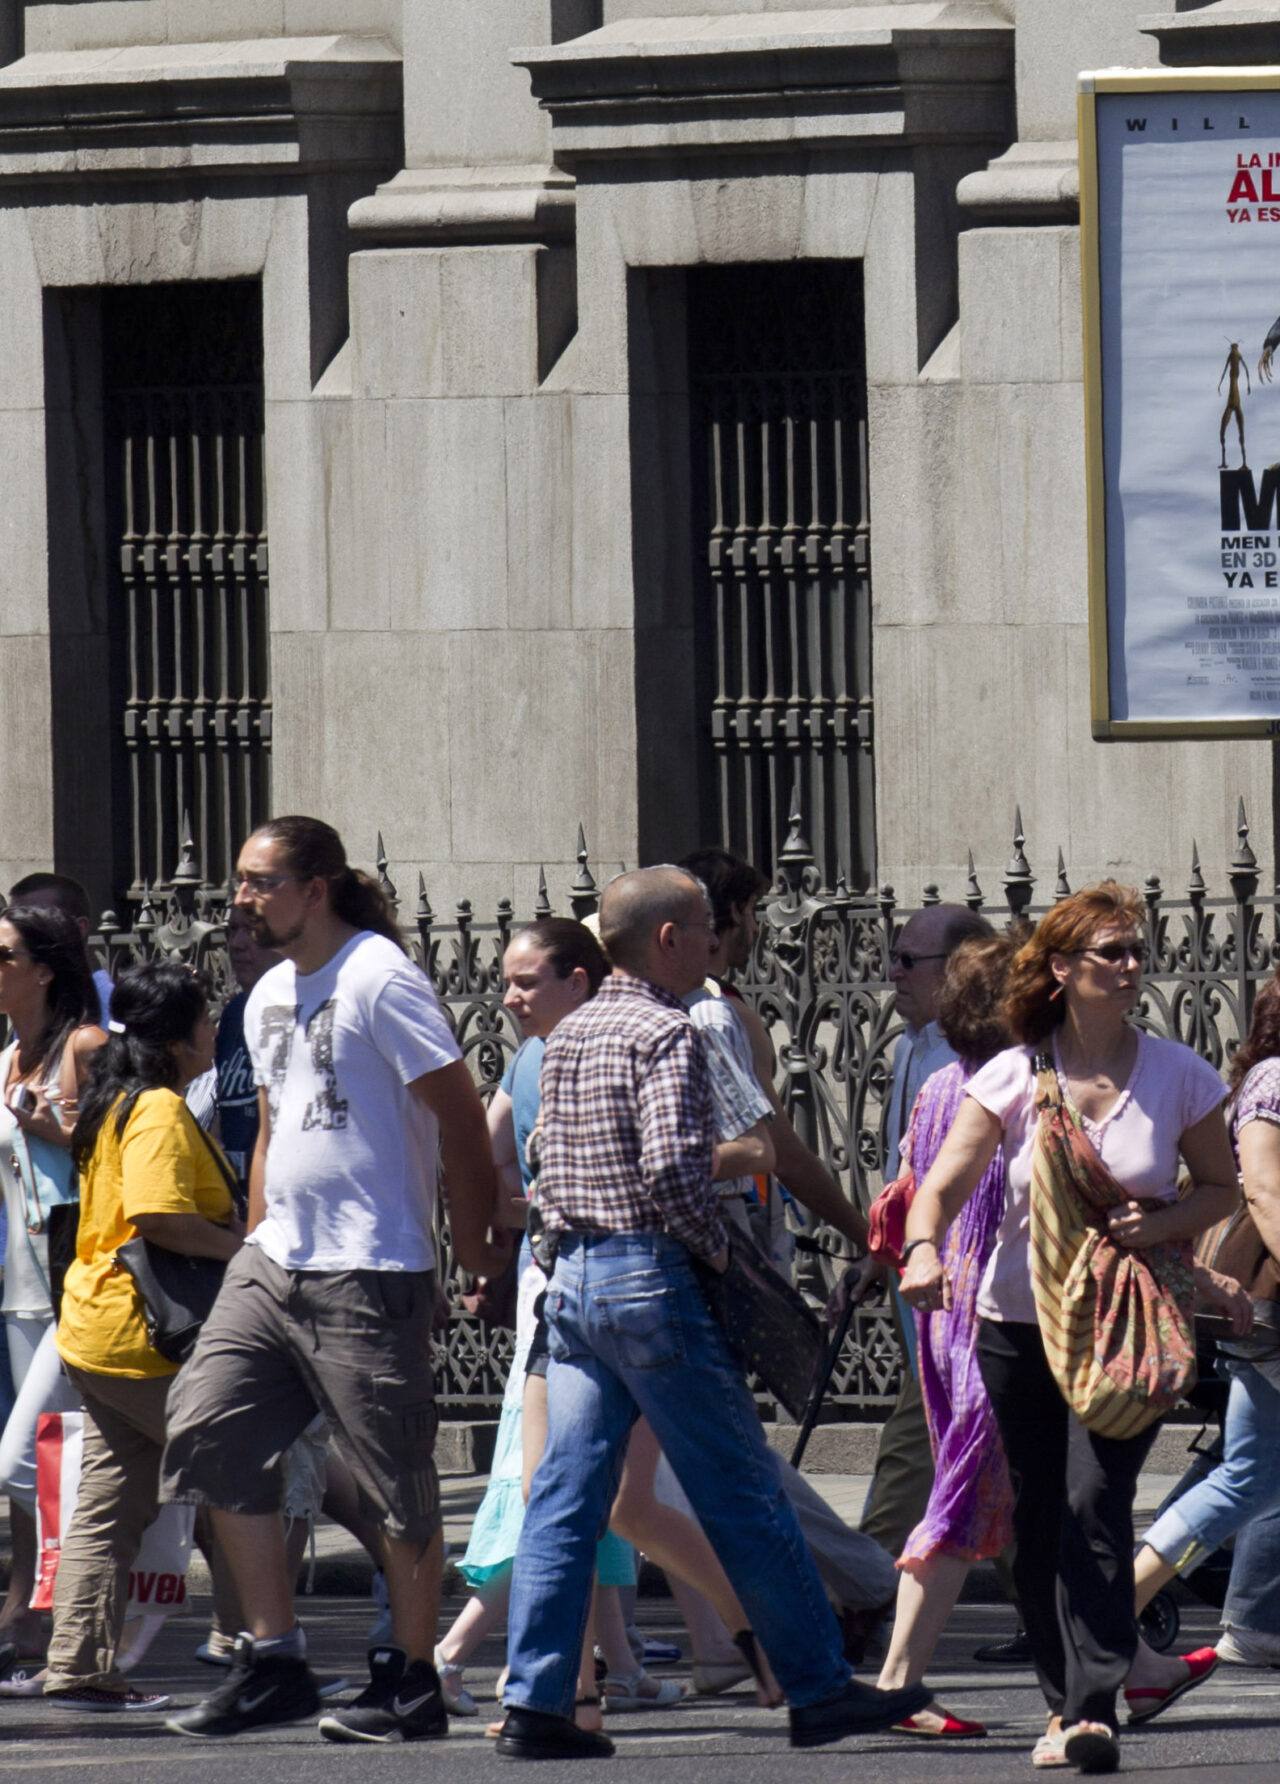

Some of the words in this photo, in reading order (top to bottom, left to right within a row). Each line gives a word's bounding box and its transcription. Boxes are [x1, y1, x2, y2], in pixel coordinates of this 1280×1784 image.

[1125, 116, 1251, 132] WILL
[1236, 152, 1261, 169] LA
[1225, 208, 1251, 223] YA
[1220, 535, 1270, 550] MEN
[1221, 551, 1246, 568] EN
[1252, 551, 1277, 568] 3D
[1223, 571, 1254, 588] YA
